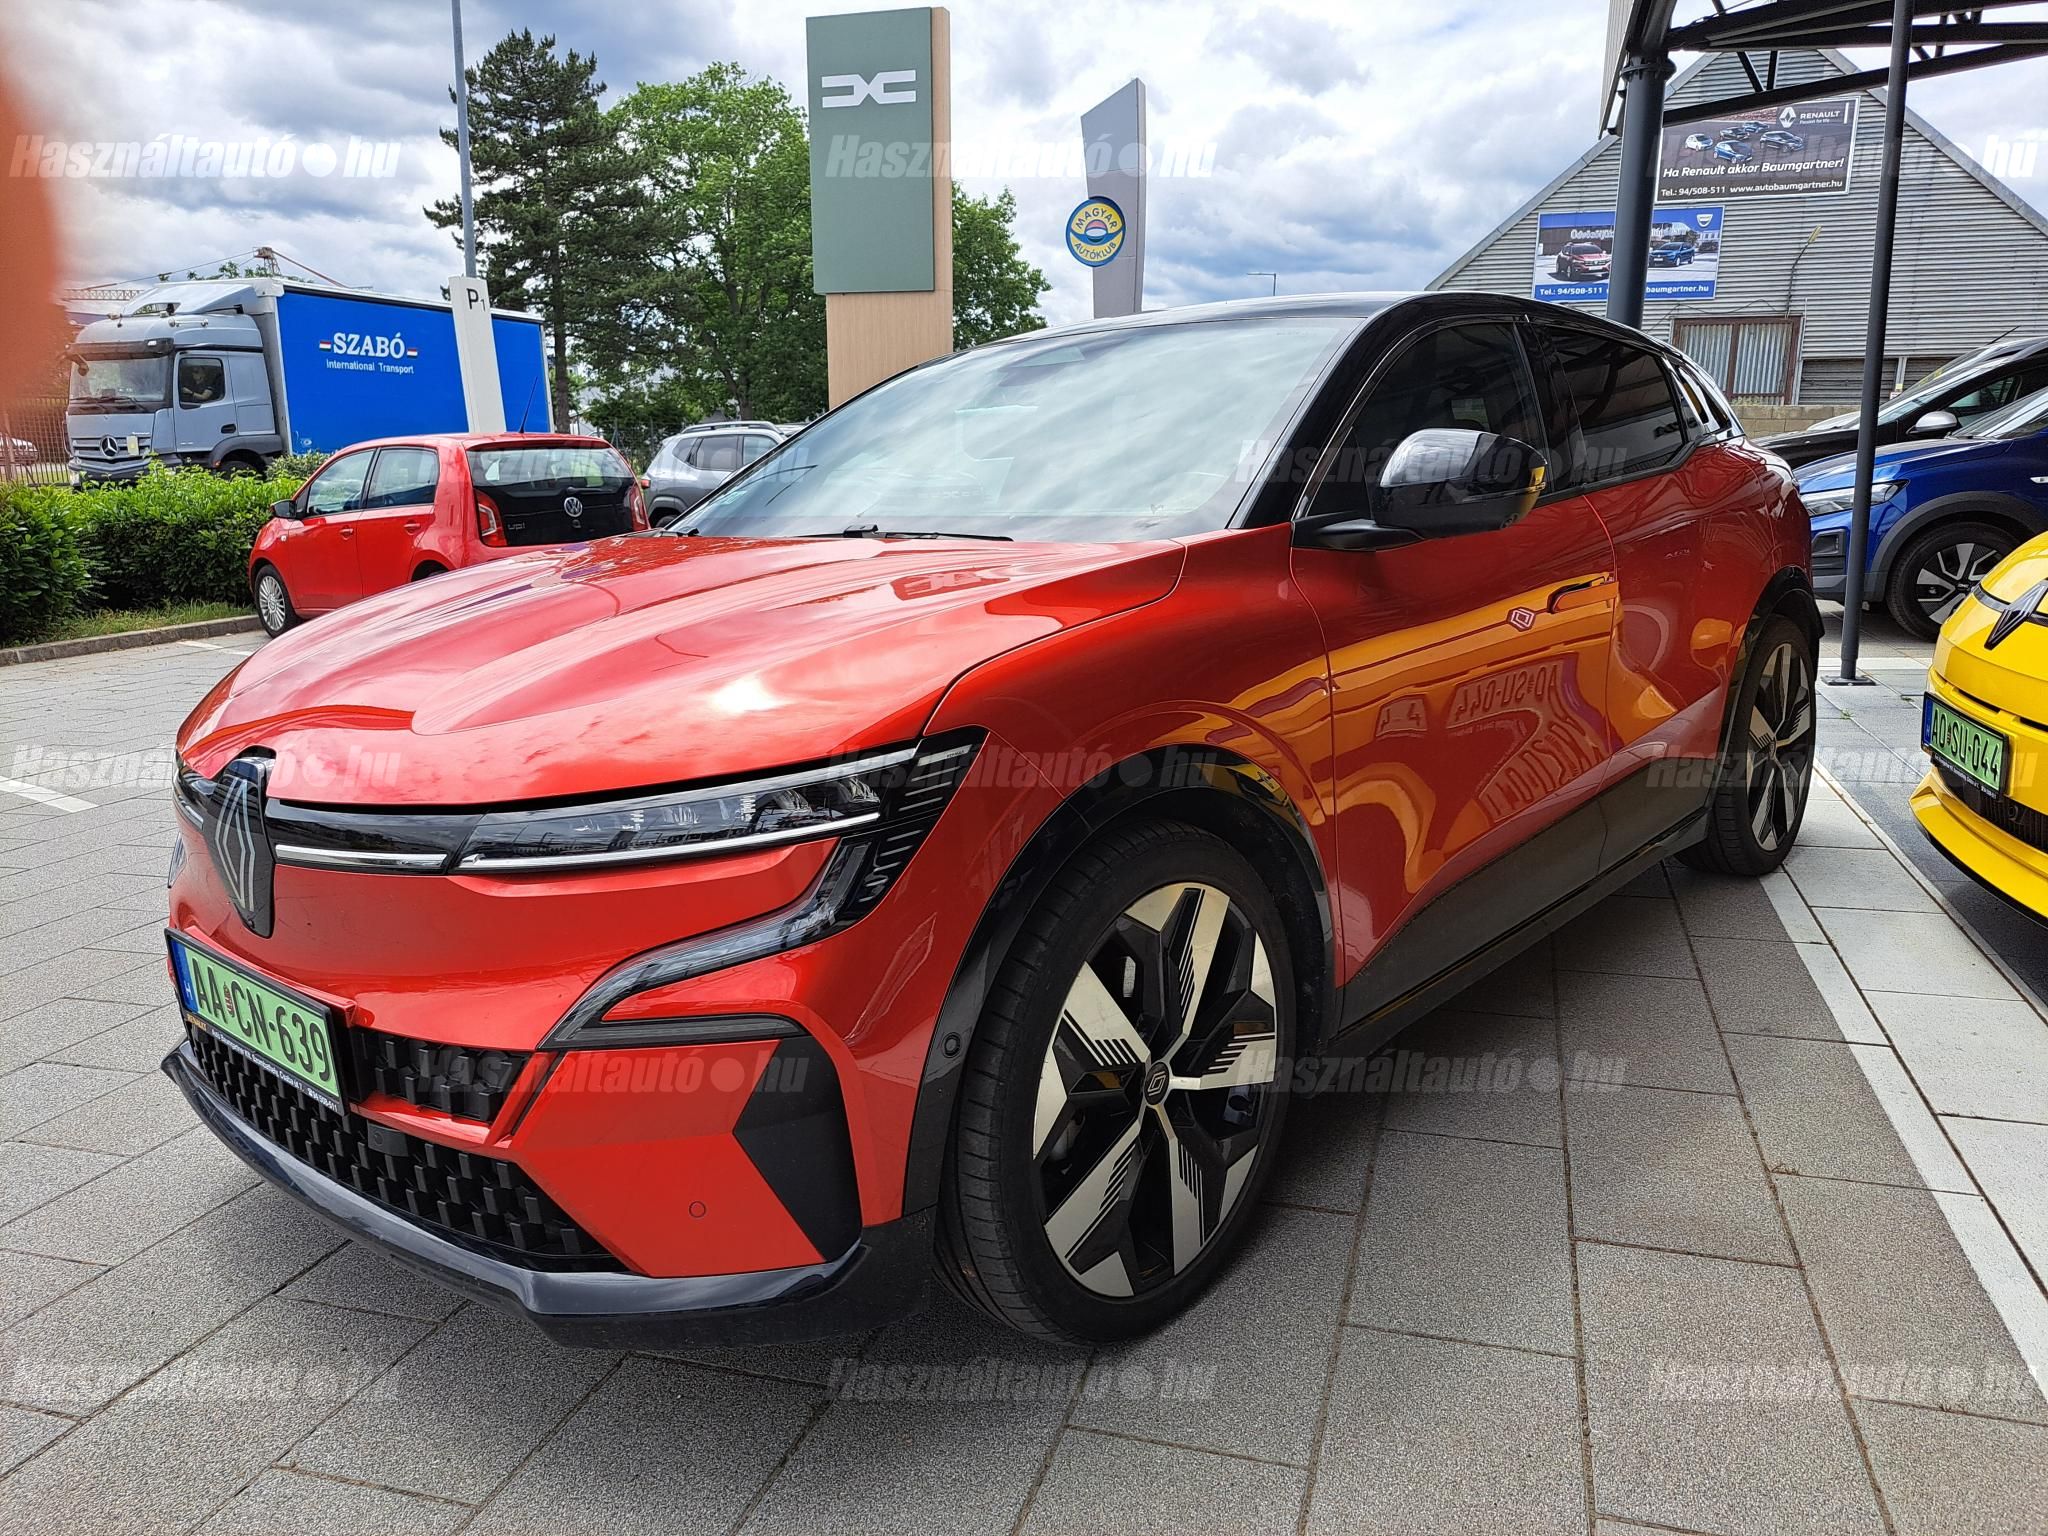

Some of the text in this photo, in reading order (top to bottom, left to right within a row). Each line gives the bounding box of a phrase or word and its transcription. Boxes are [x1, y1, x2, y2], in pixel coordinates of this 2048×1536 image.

[1800, 110, 1841, 119] RENAULT
[1663, 158, 1845, 178] Ha Renault akkor Baumgartner!
[1661, 180, 1842, 197] Tel.: 94/508-511 www.autobaumgartner.hu
[1075, 208, 1118, 229] MAGYAR
[1074, 242, 1116, 260] AUTÓKLUB
[1540, 288, 1556, 296] Tel.:
[333, 332, 405, 359] SZABÓ
[326, 359, 414, 375] International Transport
[231, 980, 330, 1082] CN-639
